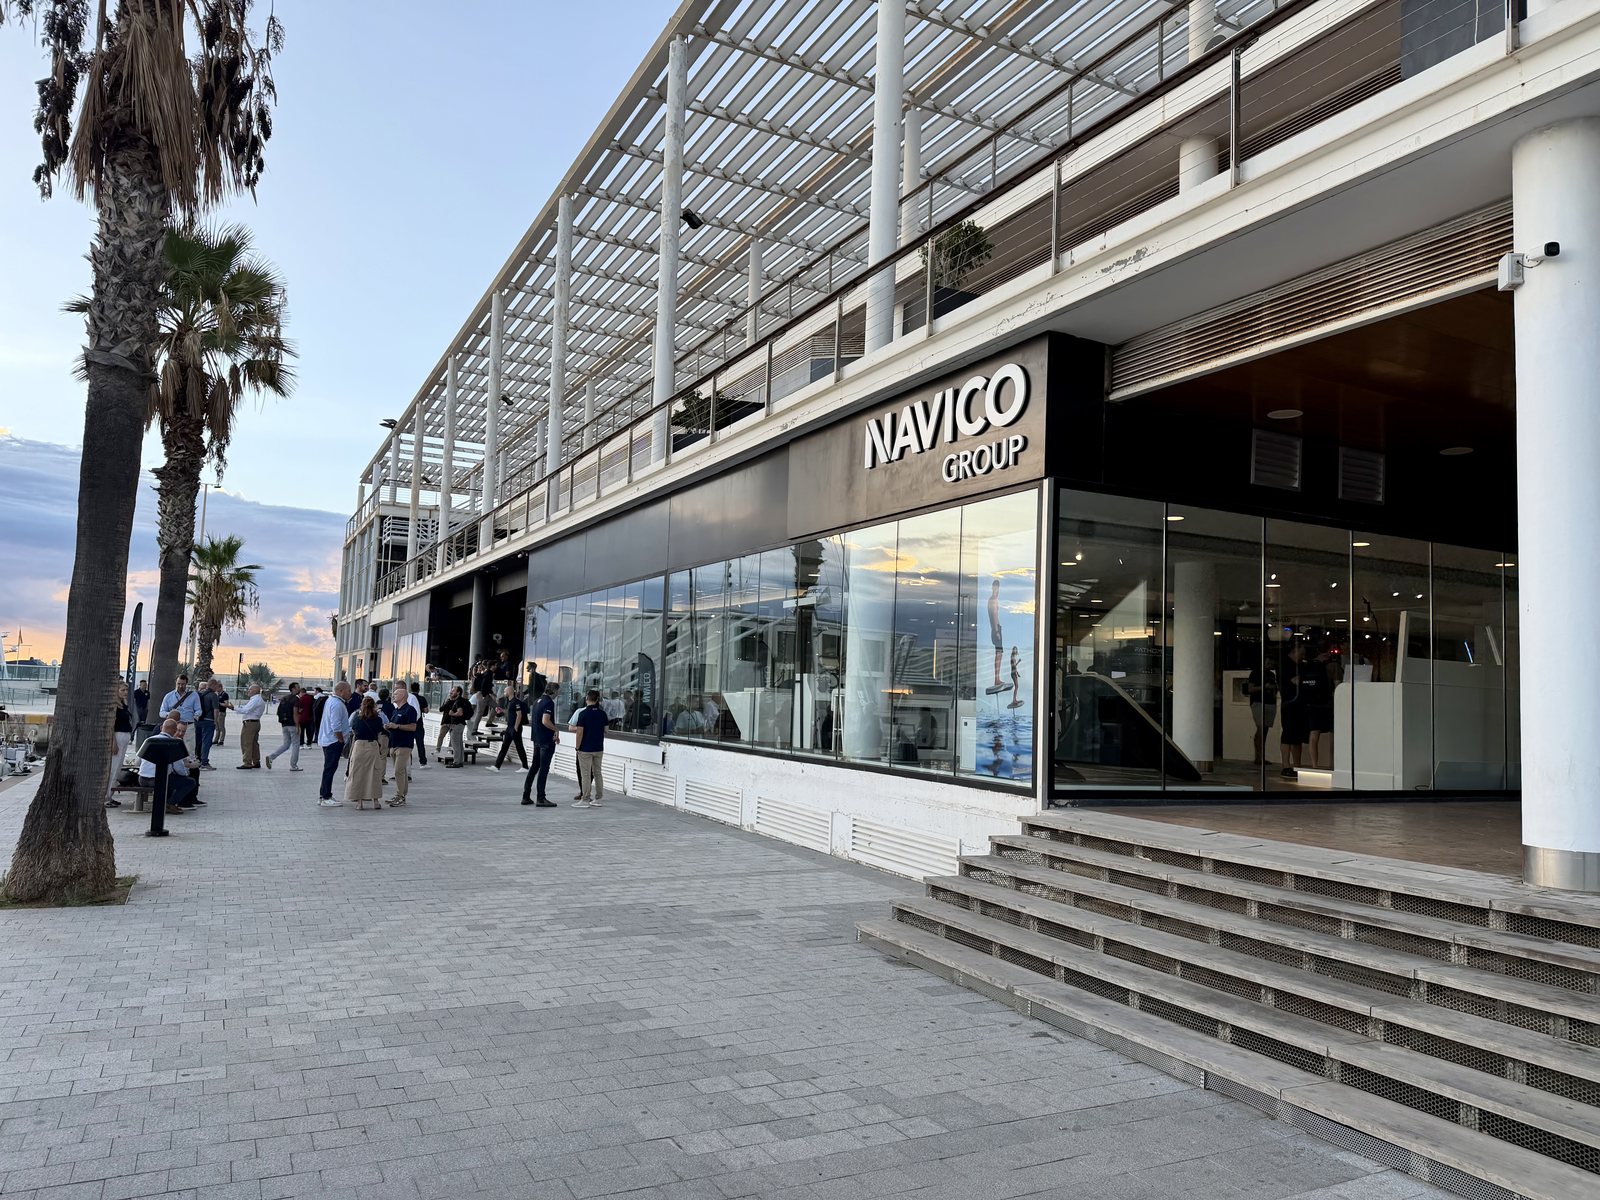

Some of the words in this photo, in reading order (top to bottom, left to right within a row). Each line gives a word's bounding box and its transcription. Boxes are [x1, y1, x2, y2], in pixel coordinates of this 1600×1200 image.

[865, 363, 1027, 468] NAVICO
[942, 434, 1025, 482] GROUP
[128, 634, 137, 683] NAVICO
